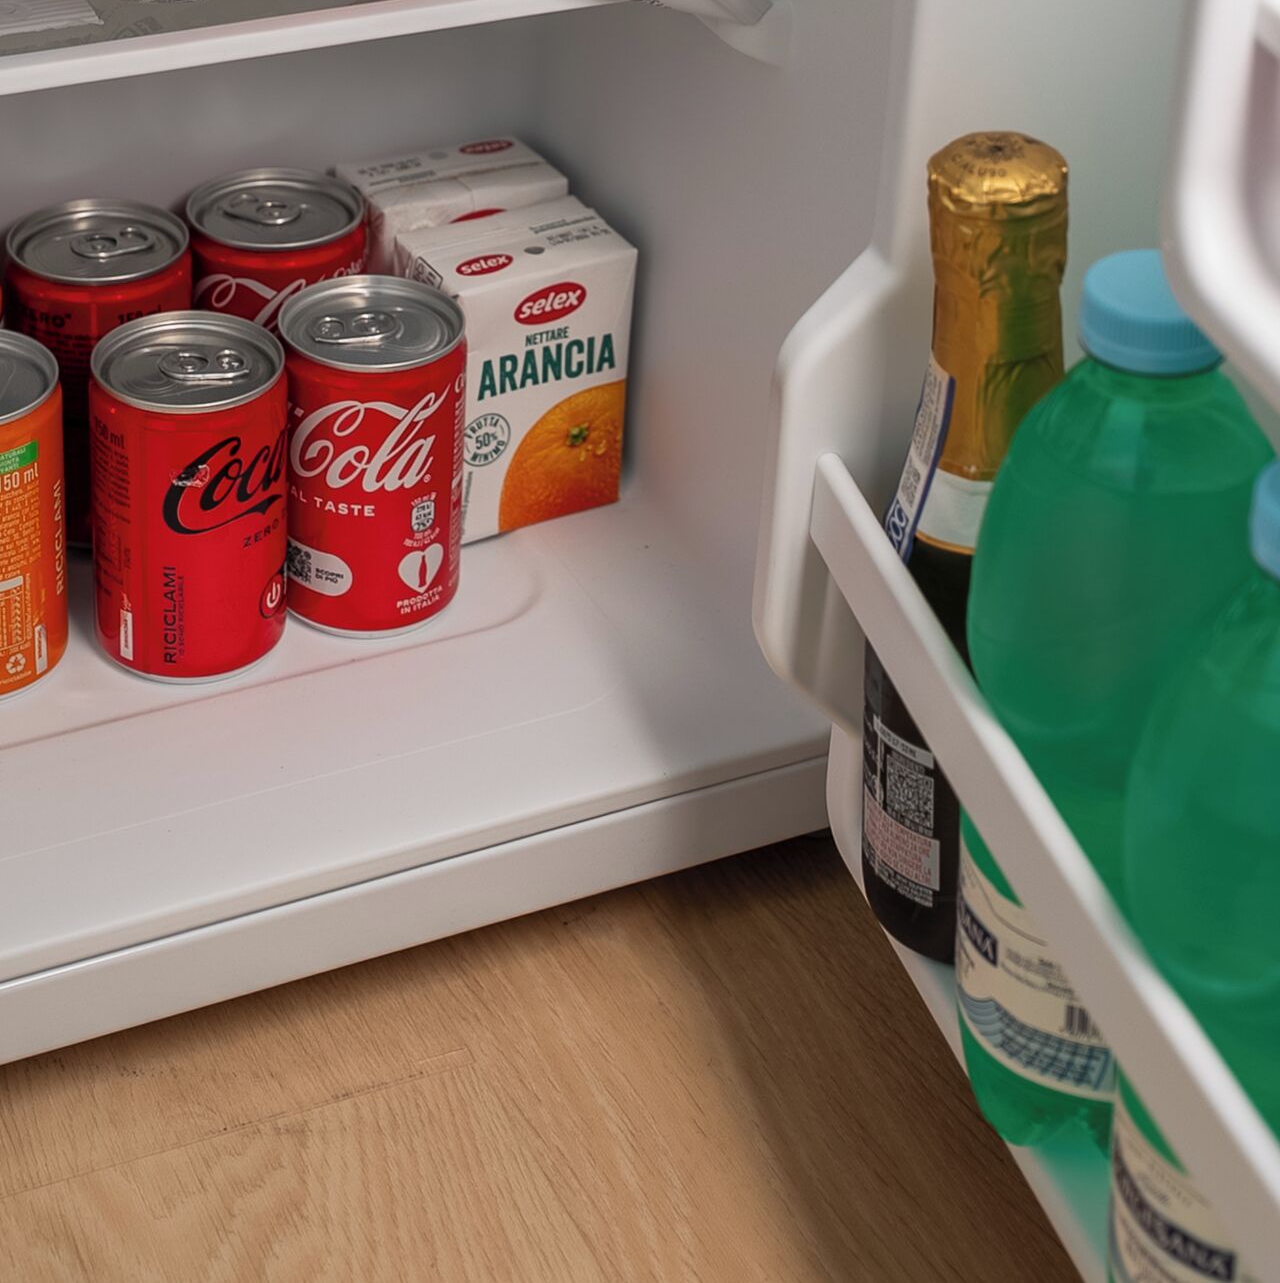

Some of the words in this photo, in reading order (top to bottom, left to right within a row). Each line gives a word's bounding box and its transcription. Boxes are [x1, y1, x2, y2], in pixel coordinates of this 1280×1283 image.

[460, 255, 510, 275] selex
[518, 289, 583, 322] selex
[524, 325, 569, 348] NETTARE
[477, 333, 615, 402] ARANCIA
[289, 382, 451, 494] Cola
[474, 431, 499, 450] 50%
[470, 439, 507, 463] MINIMO
[23, 462, 39, 484] ml
[162, 428, 287, 536] Coca
[313, 495, 376, 517] TASTE
[52, 478, 65, 596] RICICLAMI
[242, 518, 280, 548] ZERO
[396, 585, 443, 609] PRODOTTA
[400, 604, 411, 615] IN
[412, 594, 440, 613] ITALIA
[162, 566, 177, 664] RICICLAMI
